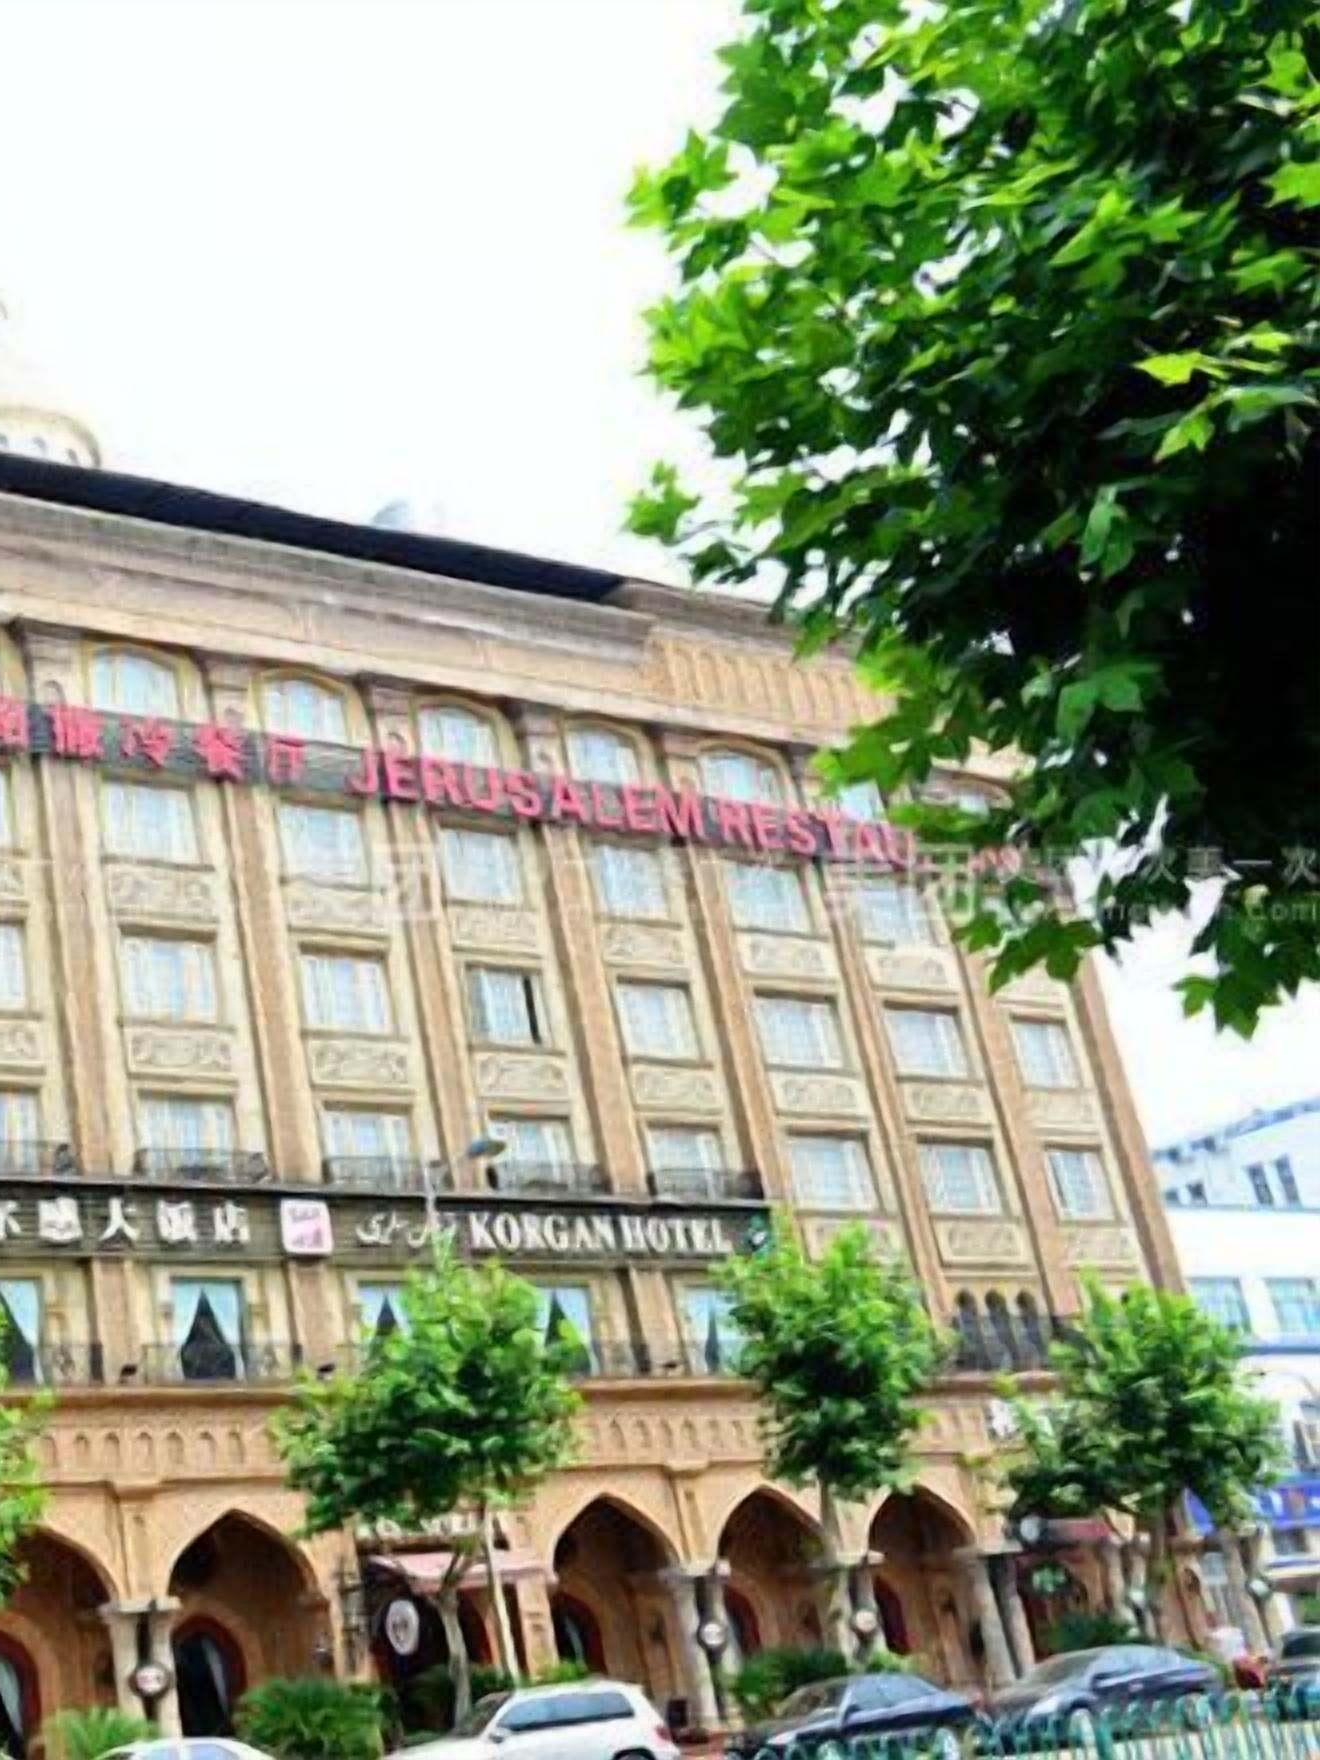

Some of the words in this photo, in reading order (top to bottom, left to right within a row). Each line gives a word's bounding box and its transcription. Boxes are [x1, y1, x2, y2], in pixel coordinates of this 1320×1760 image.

[344, 744, 706, 842] JERUSALEM
[468, 1210, 618, 1252] KORGAN
[620, 1213, 735, 1253] HOTEL
